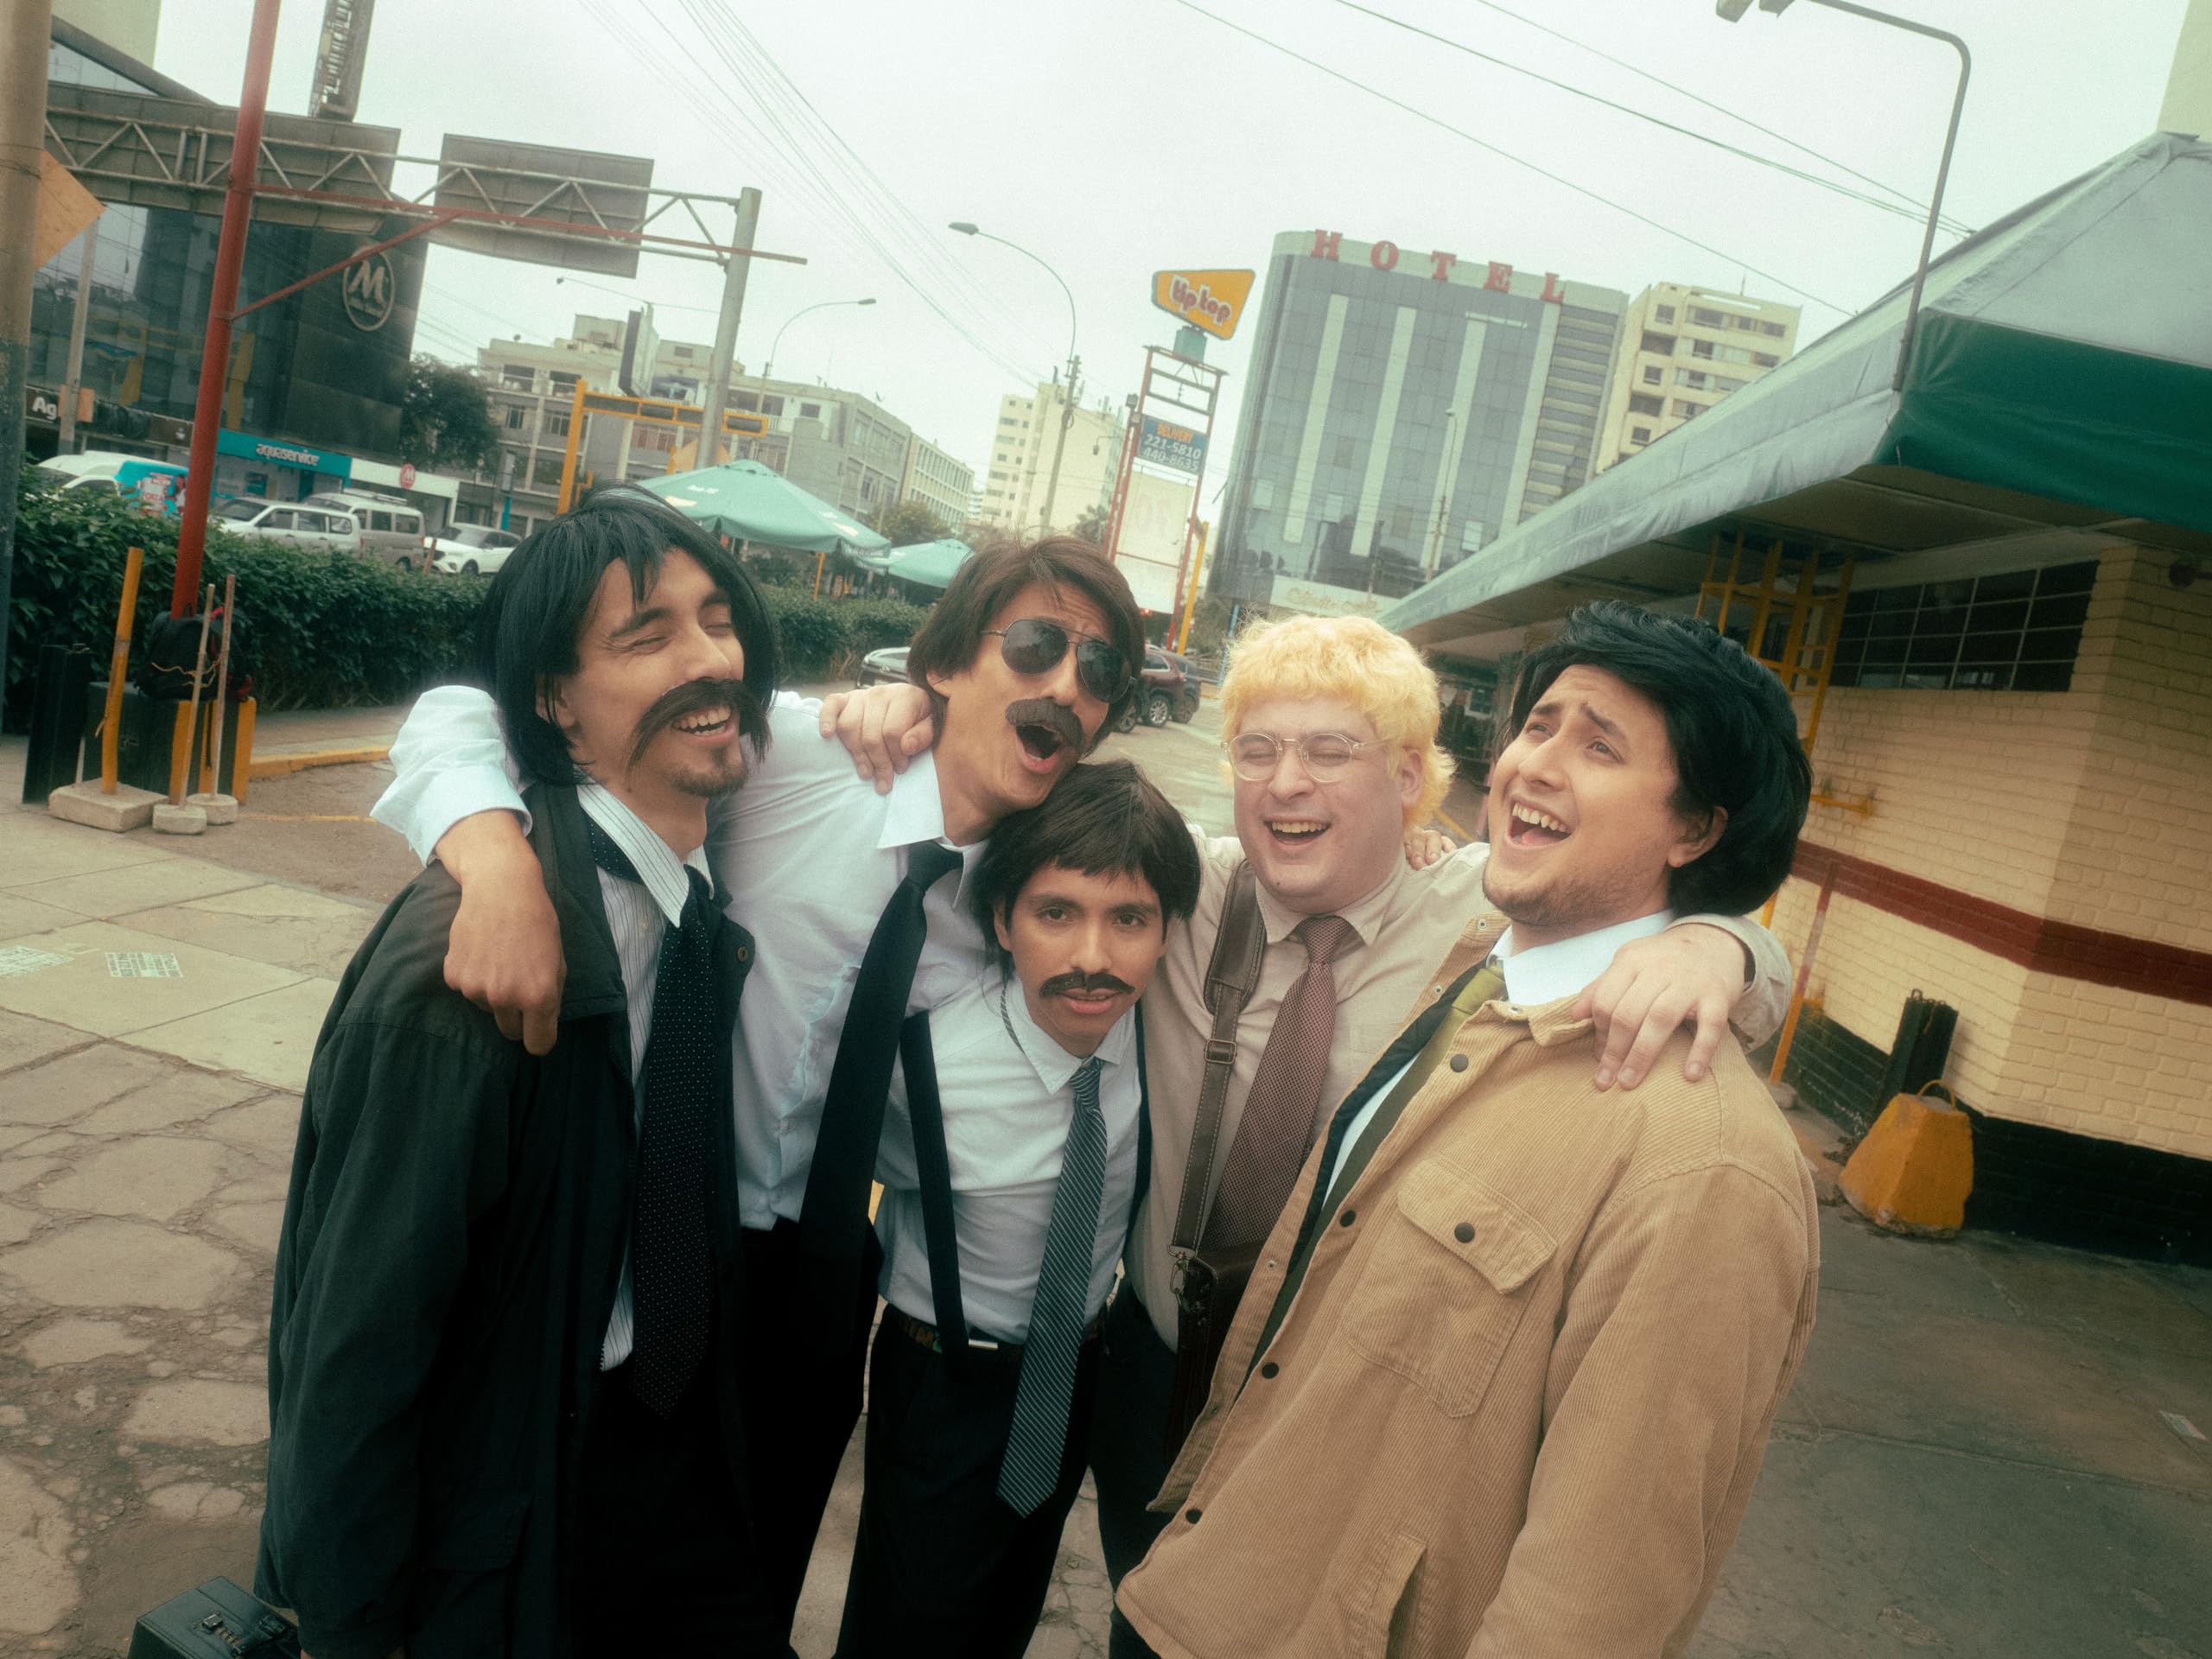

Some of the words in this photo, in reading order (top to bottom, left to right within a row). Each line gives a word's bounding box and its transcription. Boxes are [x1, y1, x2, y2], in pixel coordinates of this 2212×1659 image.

[1310, 229, 1565, 302] HOTEL
[32, 397, 57, 420] Ag
[256, 443, 320, 467] aquaservice
[1145, 434, 1201, 460] 221-5810
